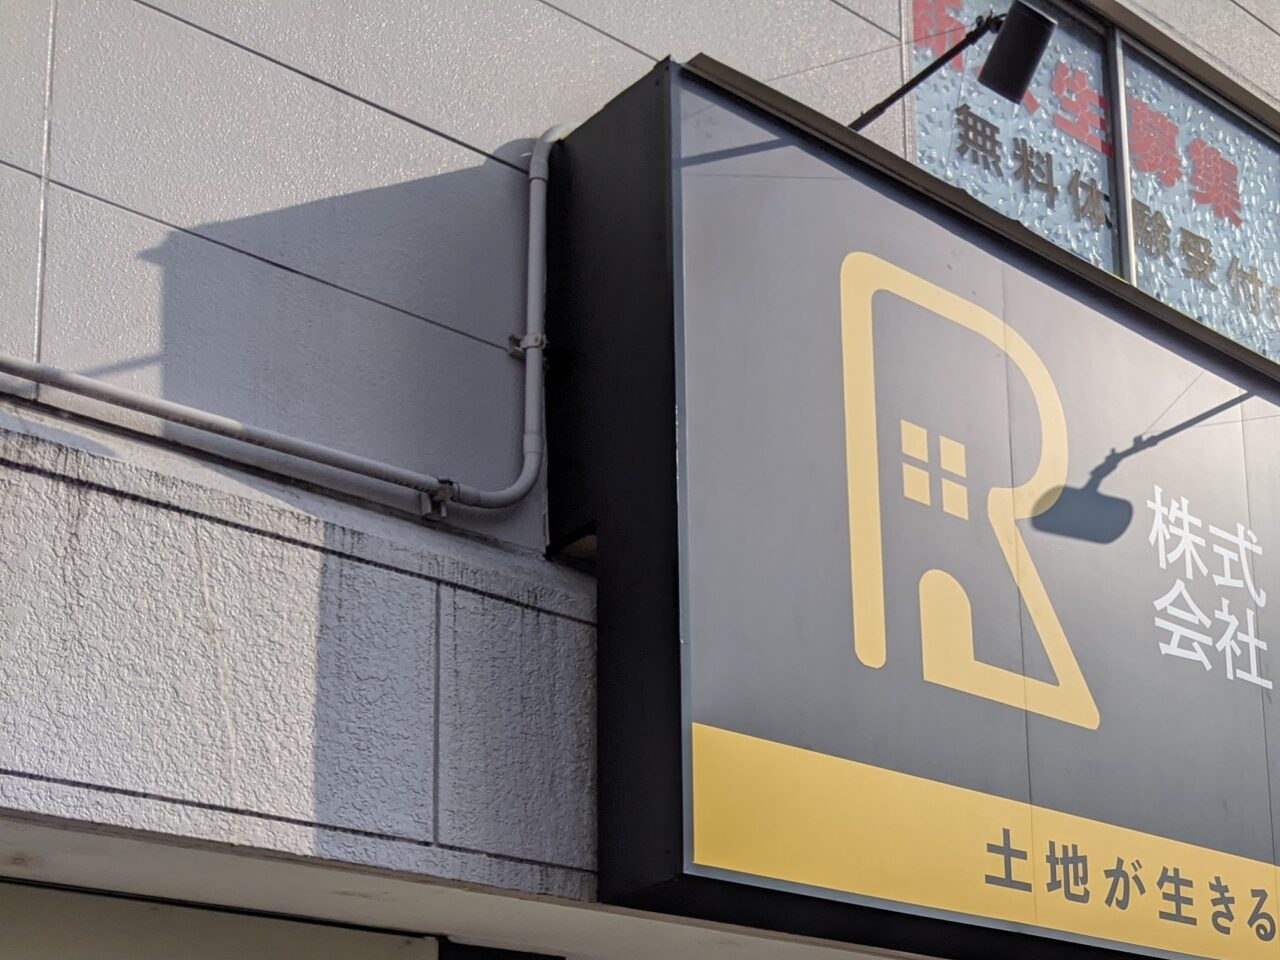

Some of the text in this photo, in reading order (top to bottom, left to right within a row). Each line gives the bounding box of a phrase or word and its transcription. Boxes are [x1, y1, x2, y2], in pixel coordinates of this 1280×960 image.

[913, 0, 1242, 228] 新生募集
[1147, 485, 1267, 608] 株式
[1153, 578, 1273, 690] 会社
